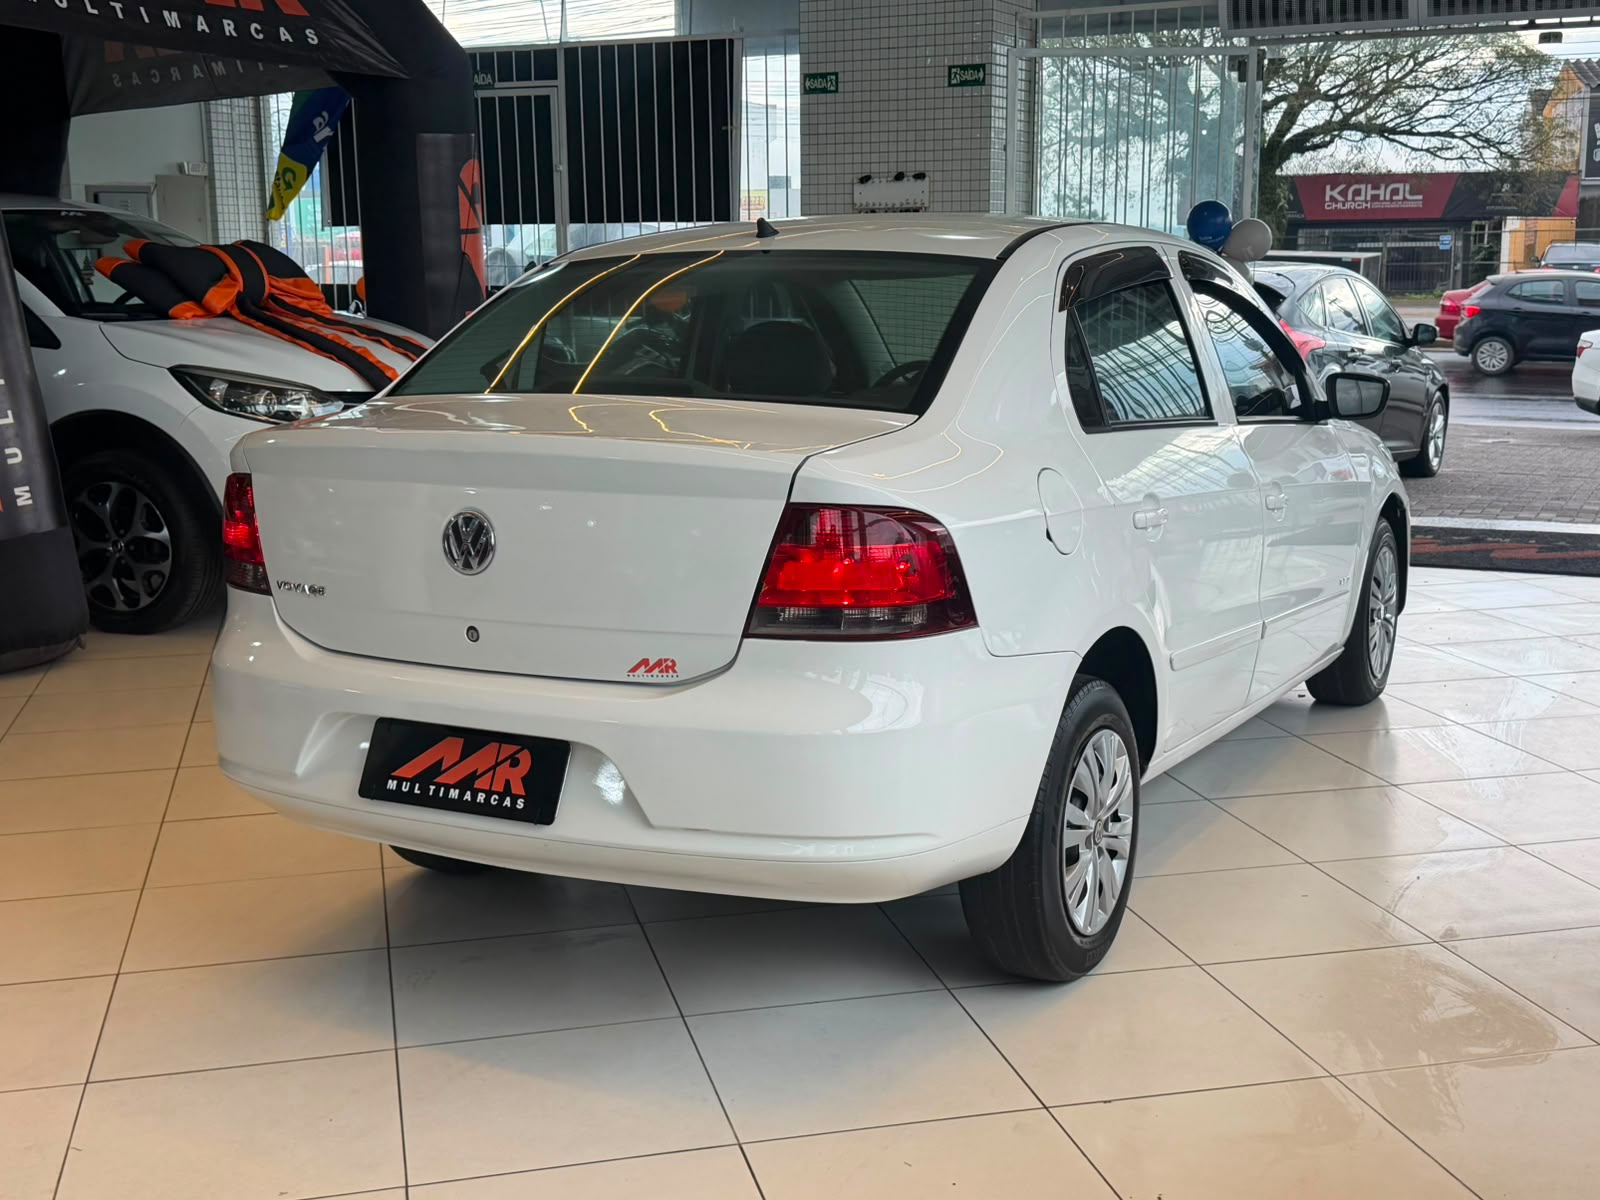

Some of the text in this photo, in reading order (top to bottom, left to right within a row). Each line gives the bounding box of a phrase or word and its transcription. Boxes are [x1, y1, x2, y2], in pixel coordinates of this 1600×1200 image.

[28, 0, 319, 44] ULTIMARCAS
[474, 72, 493, 85] AÍDA
[1325, 183, 1423, 201] KAHAL
[1325, 201, 1370, 210] CHURCH
[386, 779, 526, 810] MULTIMARCAS
